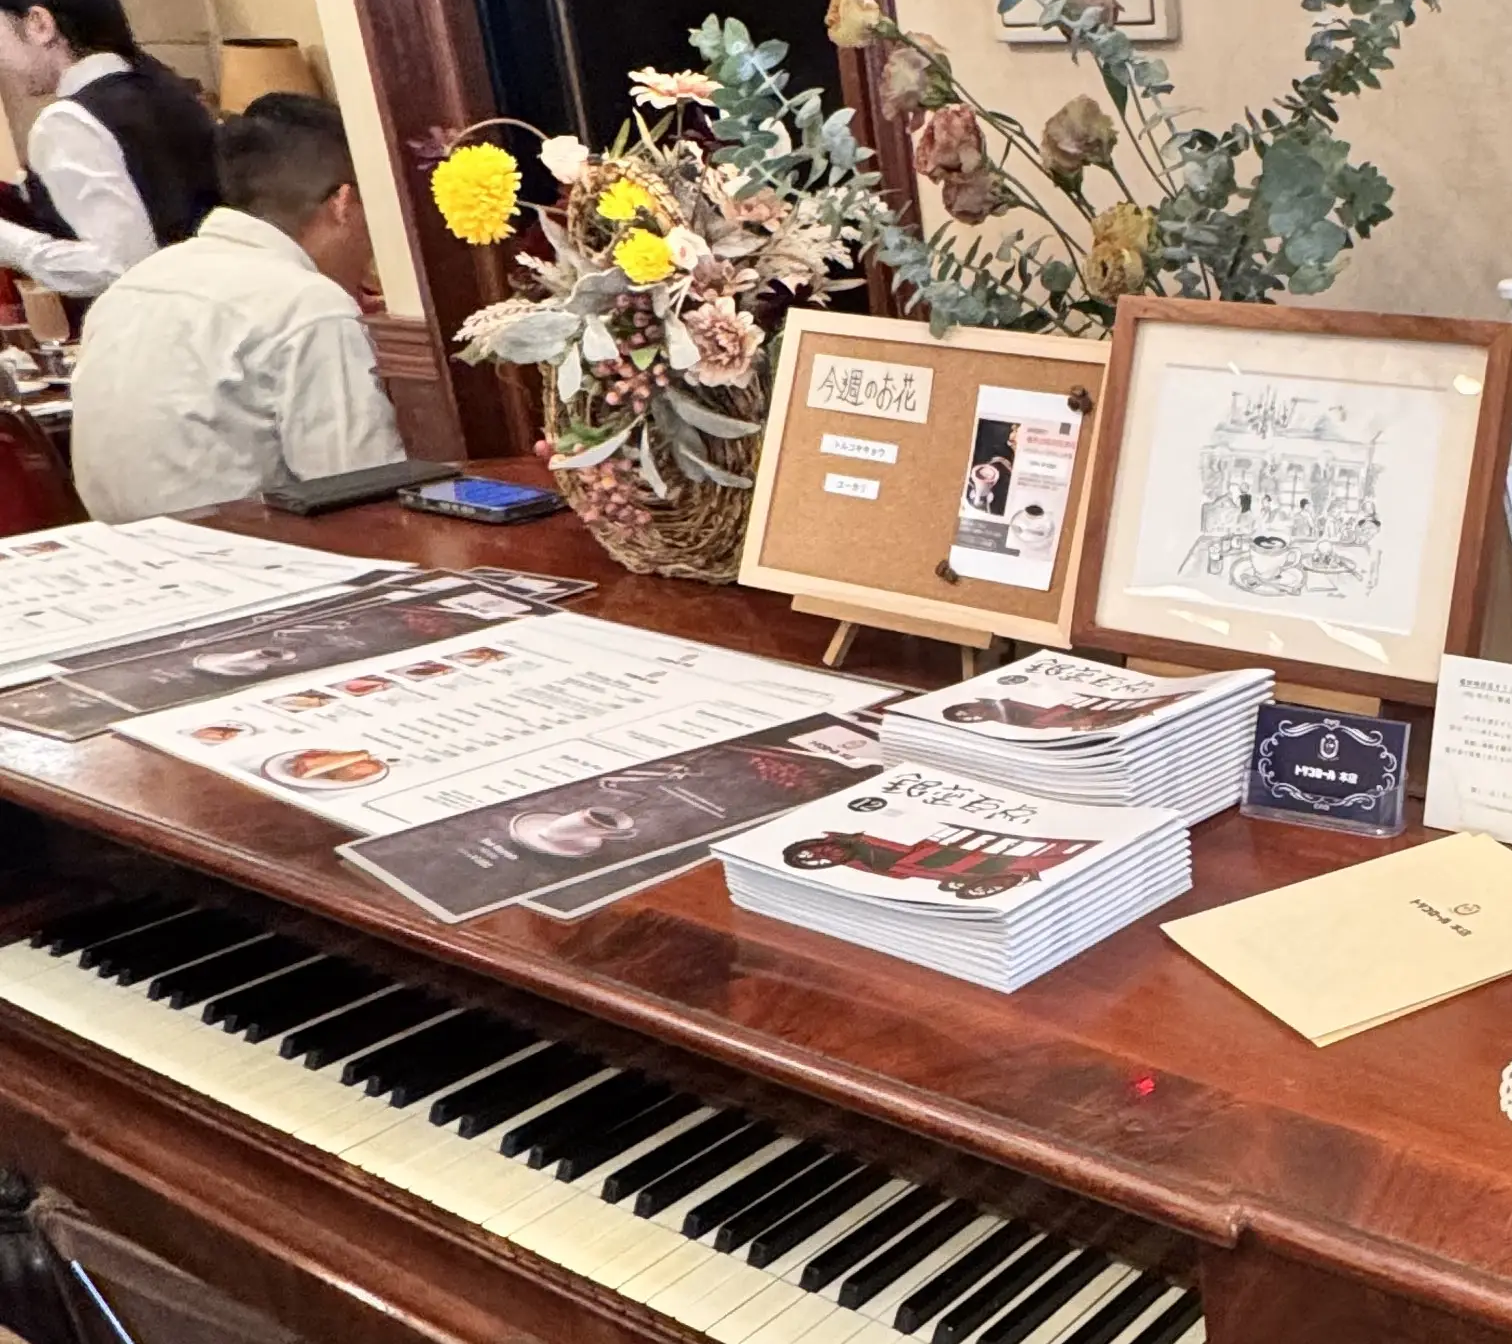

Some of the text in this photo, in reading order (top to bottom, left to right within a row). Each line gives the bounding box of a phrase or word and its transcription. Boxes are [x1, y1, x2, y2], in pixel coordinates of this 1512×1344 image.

[817, 365, 917, 413] 今週のお花
